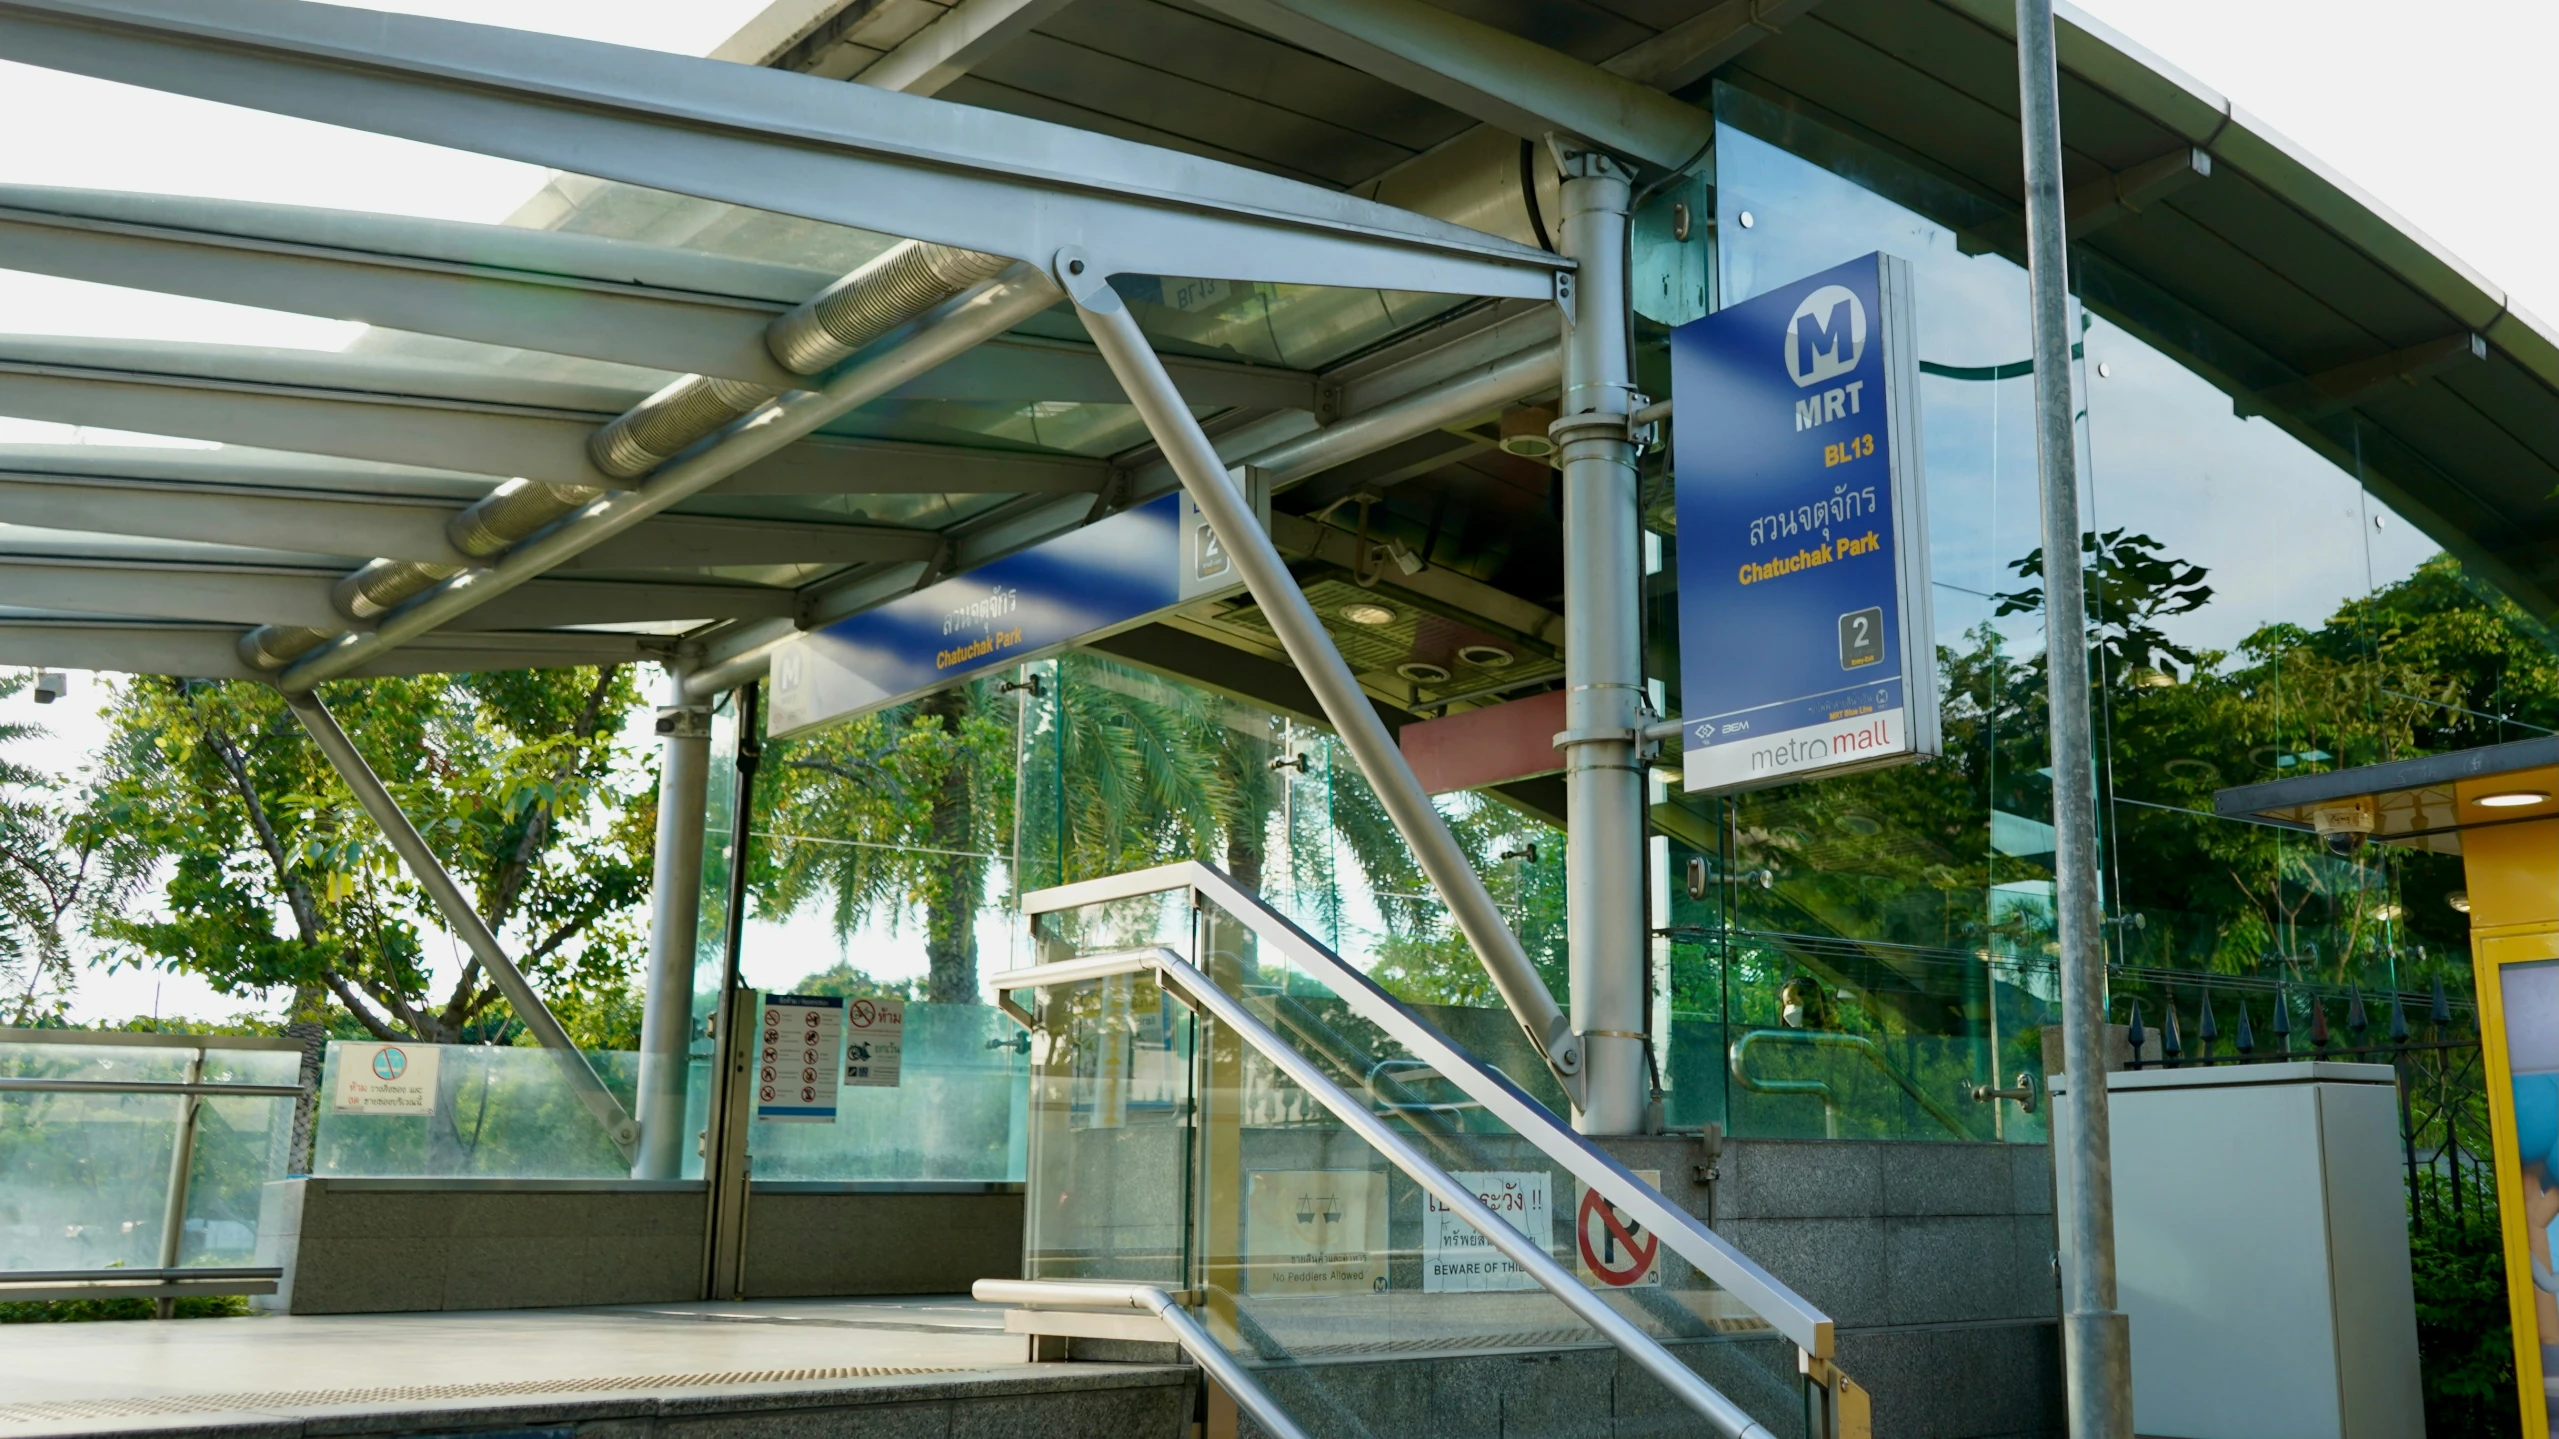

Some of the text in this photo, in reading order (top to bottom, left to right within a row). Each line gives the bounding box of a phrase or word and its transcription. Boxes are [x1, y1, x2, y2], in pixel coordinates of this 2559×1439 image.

[1795, 380, 1864, 432] MRT
[1824, 433, 1875, 468] BL13
[1750, 483, 1876, 546] สวนจตุจักร
[1204, 528, 1219, 557] 2
[1738, 531, 1880, 585] Chatuchak Park
[943, 585, 1017, 635] สวนจตุจักร
[936, 626, 1022, 669] Chatuchak Park
[1852, 616, 1870, 648] 2
[1829, 710, 1844, 720] MRT
[1844, 707, 1859, 718] Blue
[1833, 719, 1891, 755] mall
[1272, 1269, 1364, 1282] No Peddlers Allowed
[1434, 1263, 1480, 1275] BEWARE
[1484, 1263, 1498, 1273] OF
